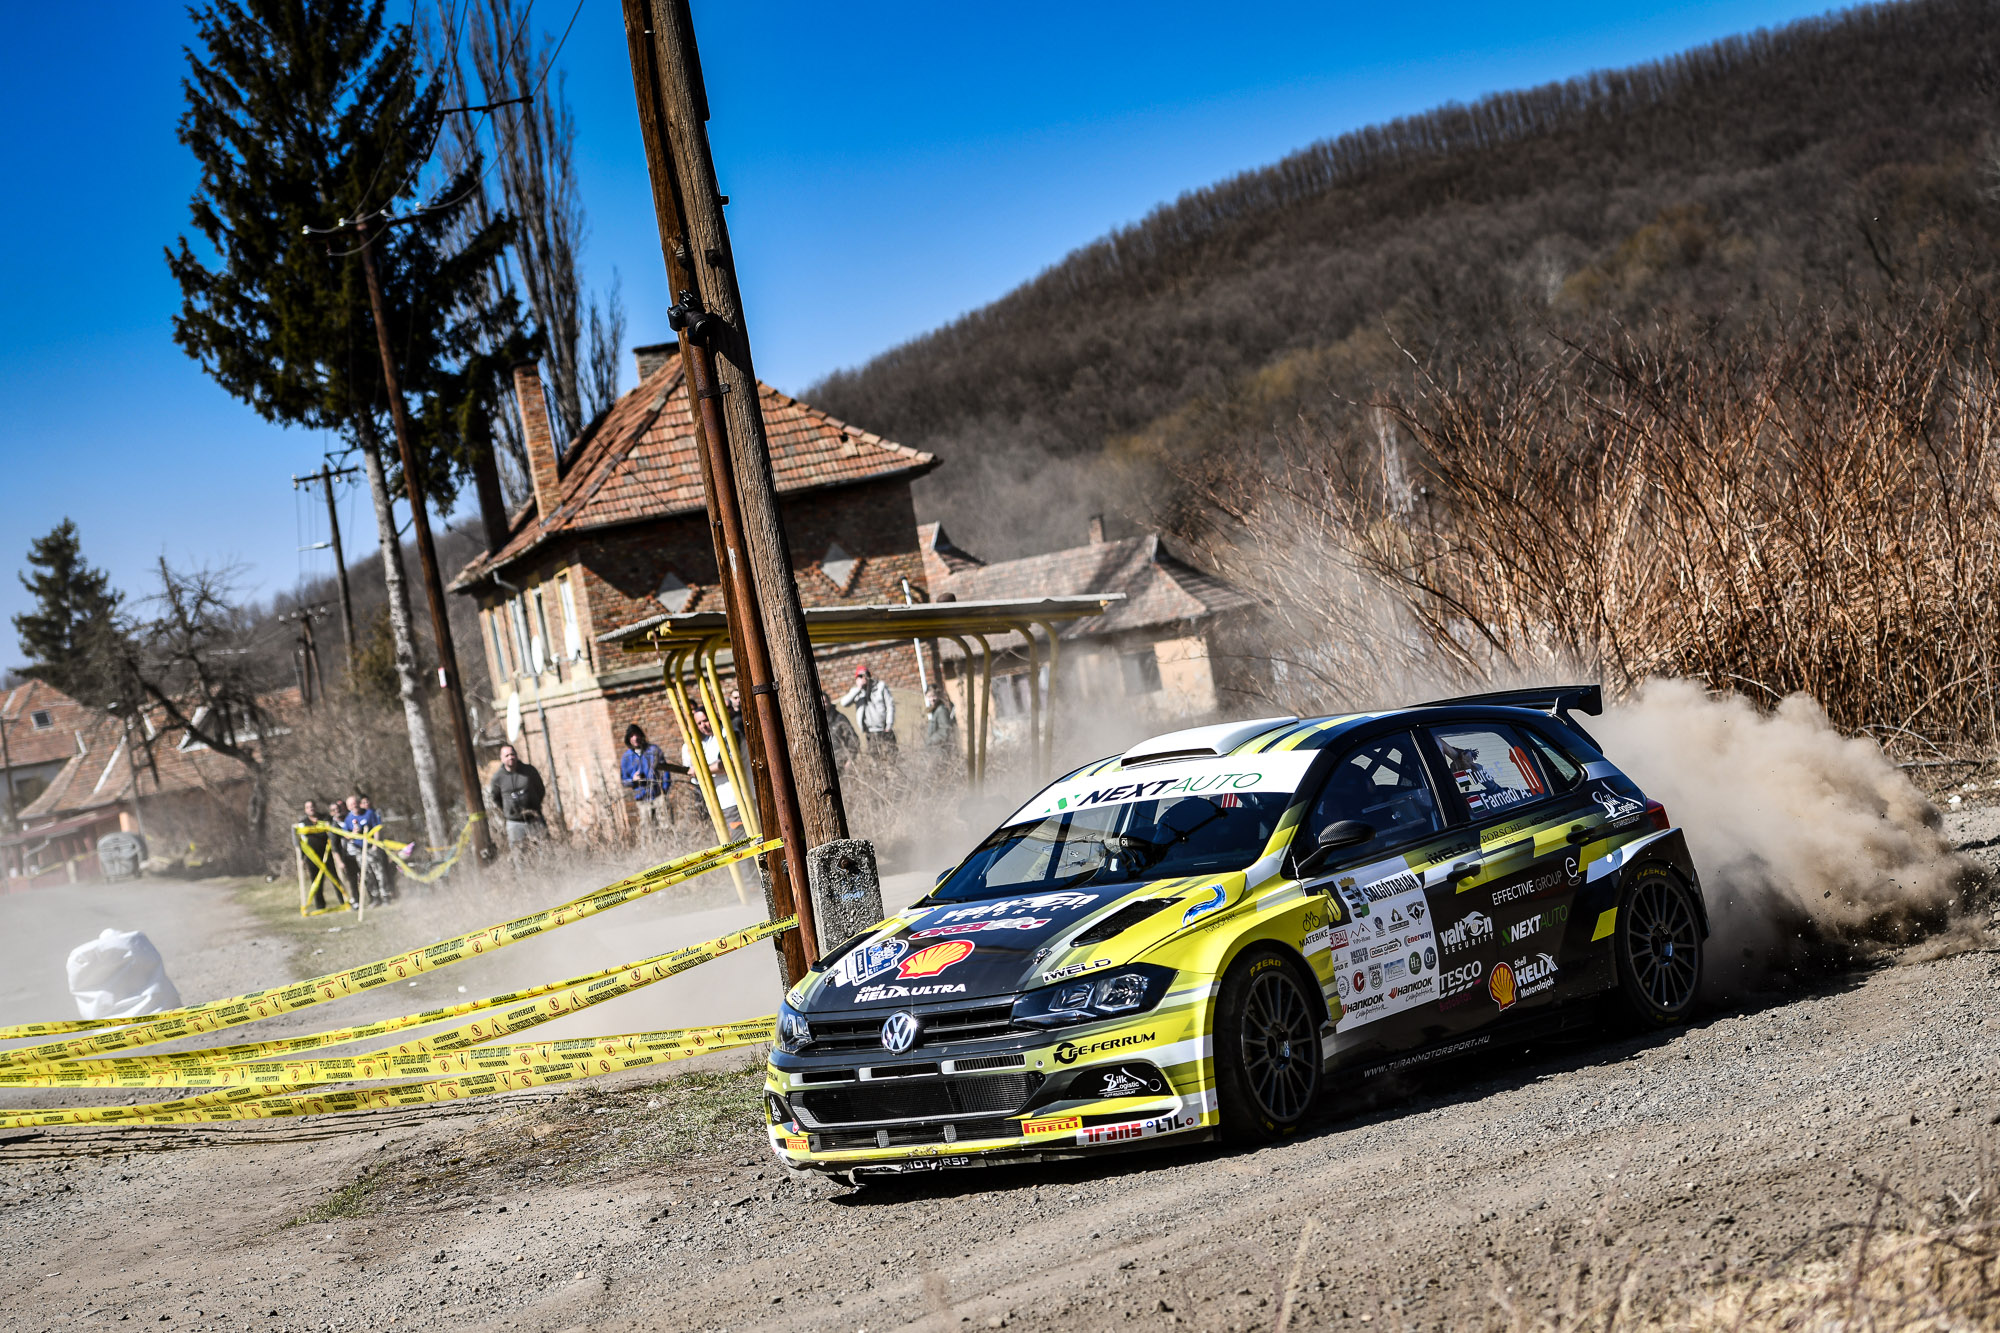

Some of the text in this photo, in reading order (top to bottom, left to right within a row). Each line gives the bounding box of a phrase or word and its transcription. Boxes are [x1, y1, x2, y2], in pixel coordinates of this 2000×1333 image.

[1508, 746, 1544, 796] 10
[1077, 773, 1262, 806] NEXTAUTO
[1481, 822, 1524, 843] PORSCHE
[1363, 874, 1419, 903] SALGÓTARJÁN
[1491, 870, 1562, 906] EFFECTIVE GROUP
[1511, 905, 1568, 942] NEXTAUTO
[1298, 928, 1329, 948] MATEBIKE
[1445, 933, 1494, 954] SECURITY
[1440, 960, 1482, 991] TESCO
[1514, 953, 1558, 987] HELIX
[854, 983, 967, 1004] HELIX ULTRA
[858, 984, 886, 994] Shell
[1023, 1116, 1079, 1134] PIRELLI
[786, 1138, 809, 1150] PIRELLI
